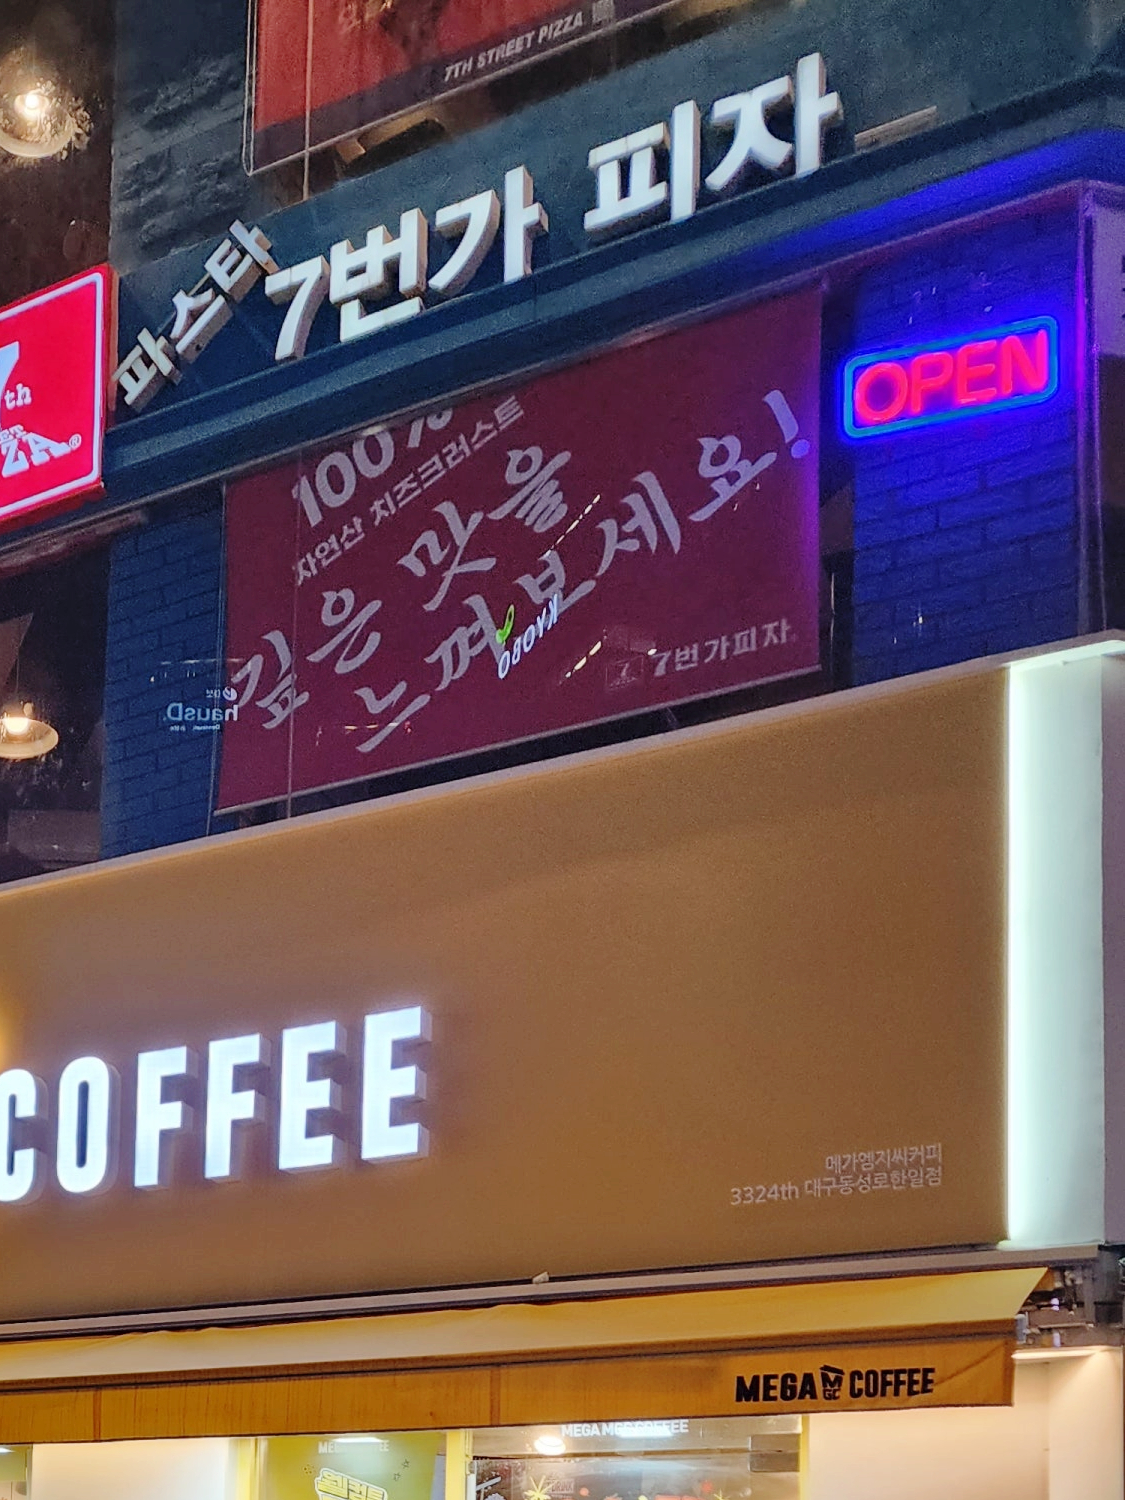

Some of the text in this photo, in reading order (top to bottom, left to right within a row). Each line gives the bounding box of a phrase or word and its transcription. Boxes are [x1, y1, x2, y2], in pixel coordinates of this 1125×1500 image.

[444, 12, 583, 83] 7TH STREET PIZZA
[263, 52, 843, 362] 7번가 피자
[111, 219, 278, 406] 파스타
[852, 327, 1055, 428] OPEN
[297, 395, 525, 587] 자연산 치즈크러스트
[229, 445, 572, 730] 깊은 맛을
[651, 618, 792, 677] 7번가피자
[730, 1181, 800, 1206] 3324th
[825, 1142, 943, 1174] 메가엠지씨커피
[735, 1367, 936, 1403] MEGA COFFEE
[561, 1422, 601, 1438] MEGA
